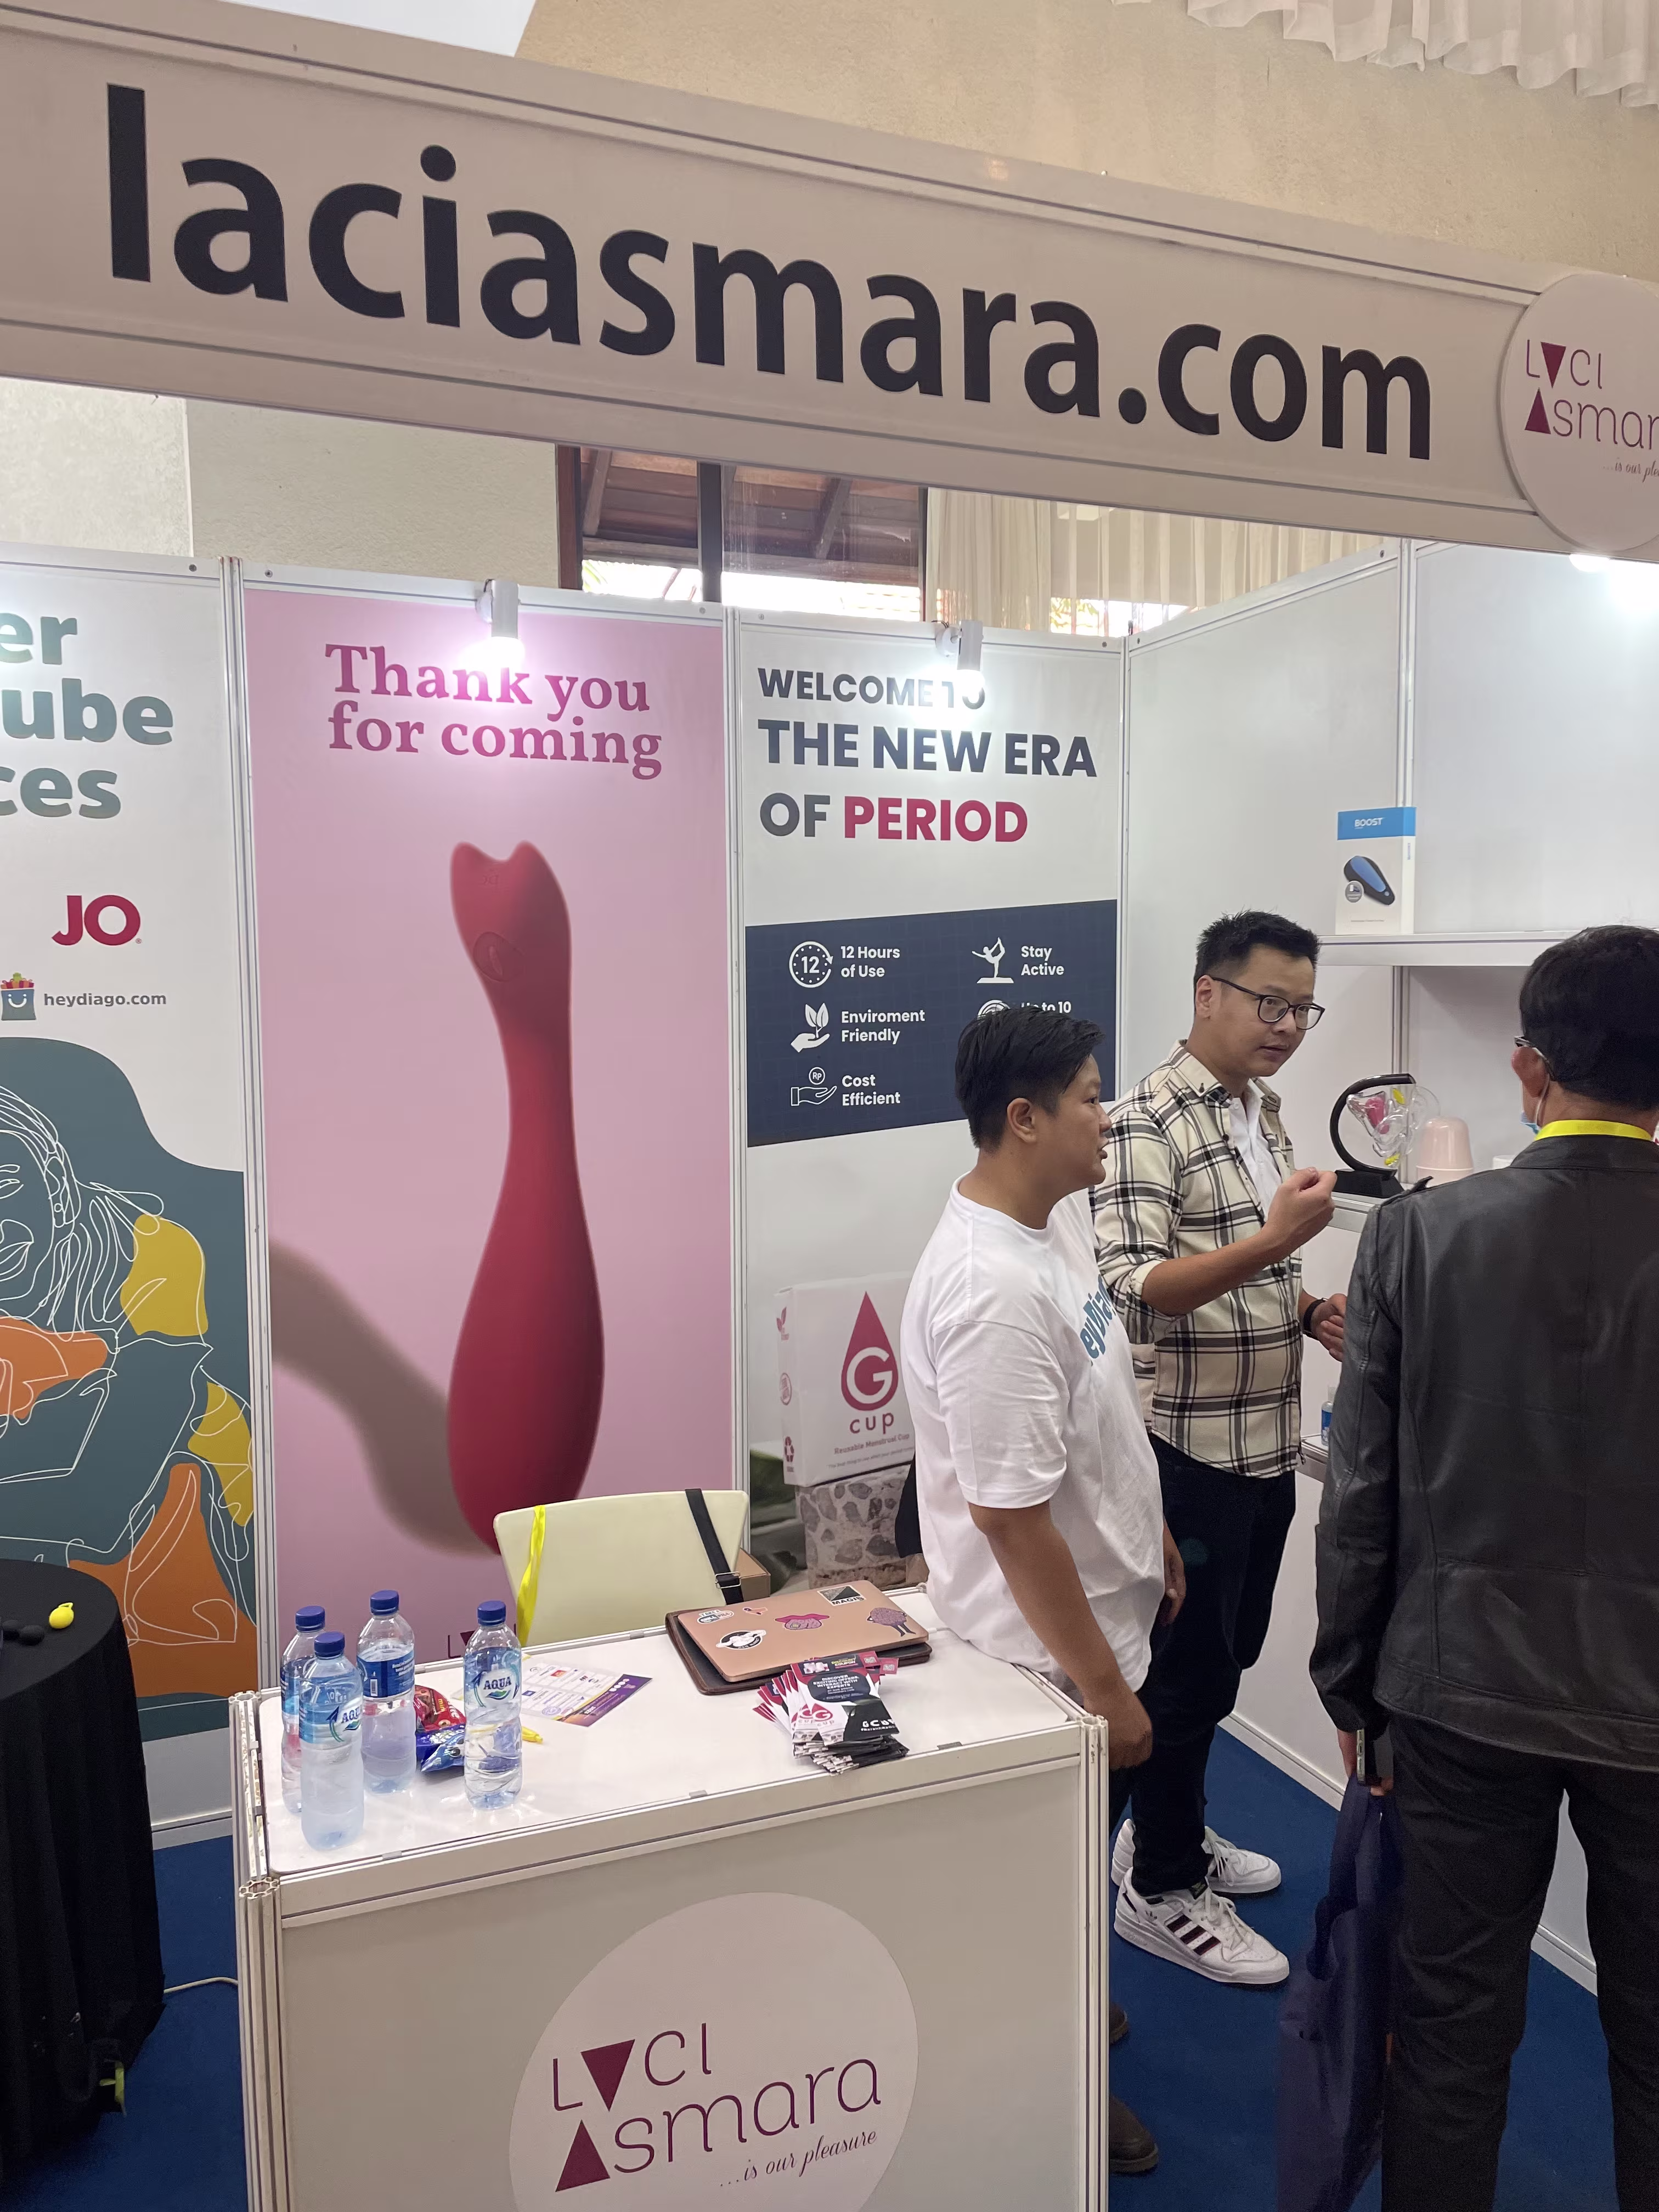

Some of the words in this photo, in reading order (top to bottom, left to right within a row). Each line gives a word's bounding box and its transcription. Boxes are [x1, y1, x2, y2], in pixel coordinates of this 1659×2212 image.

[107, 83, 1430, 460] laciasmara.com
[1626, 464, 1641, 474] our
[325, 644, 533, 704] Thank
[545, 674, 650, 721] you
[758, 668, 933, 707] WELCOME
[328, 700, 425, 753] for
[441, 716, 662, 780] coming
[758, 719, 859, 767] THE
[873, 726, 992, 772] NEW
[1005, 733, 1097, 777] ERA
[760, 792, 831, 837] OF
[844, 796, 1028, 842] PERIOD
[1354, 817, 1385, 827] BOOST
[52, 894, 141, 946] JO
[840, 946, 855, 958] 12
[857, 946, 900, 959] Hours
[1021, 946, 1052, 961] Stay
[801, 956, 820, 973] 12
[840, 964, 856, 978] of
[859, 965, 885, 978] Use
[1021, 962, 1064, 975] Active
[44, 993, 167, 1007] heydiago.com
[1058, 1001, 1072, 1013] 10
[841, 1009, 926, 1023] Enviroment
[842, 1028, 900, 1045] Friendly
[812, 1072, 822, 1081] Rp
[842, 1074, 876, 1087] Cost
[842, 1091, 901, 1106] Efficient
[850, 1412, 894, 1434] cup
[834, 1443, 864, 1454] Reusable
[866, 1435, 896, 1448] Menstrual
[483, 1676, 512, 1690] AQUA
[341, 1706, 361, 1723] AQU
[766, 2153, 796, 2175] our
[799, 2131, 877, 2177] pleasure
